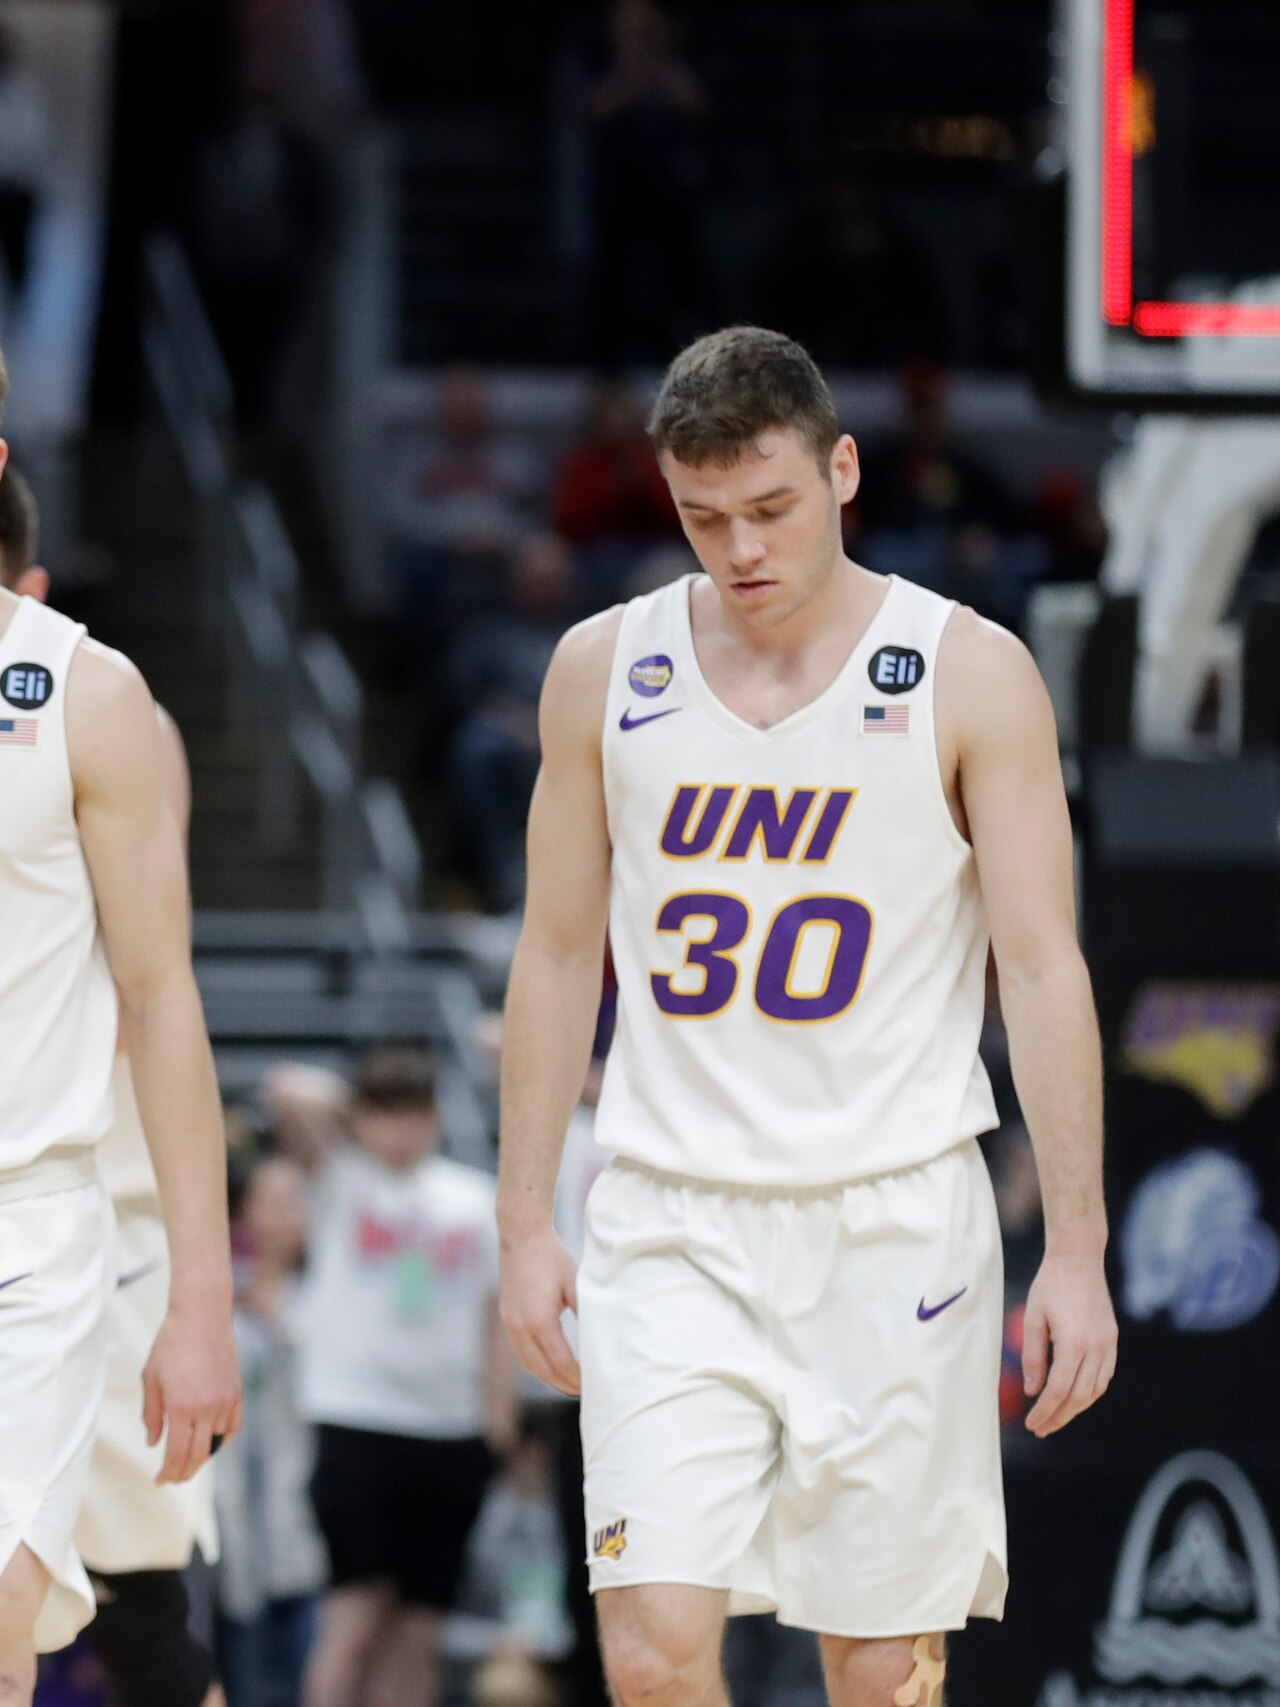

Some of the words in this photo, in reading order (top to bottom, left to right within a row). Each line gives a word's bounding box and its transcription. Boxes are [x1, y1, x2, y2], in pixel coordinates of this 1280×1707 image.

[5, 669, 47, 701] Eli
[876, 652, 918, 684] Eli
[657, 783, 860, 865] UNI
[650, 888, 875, 1026] 30
